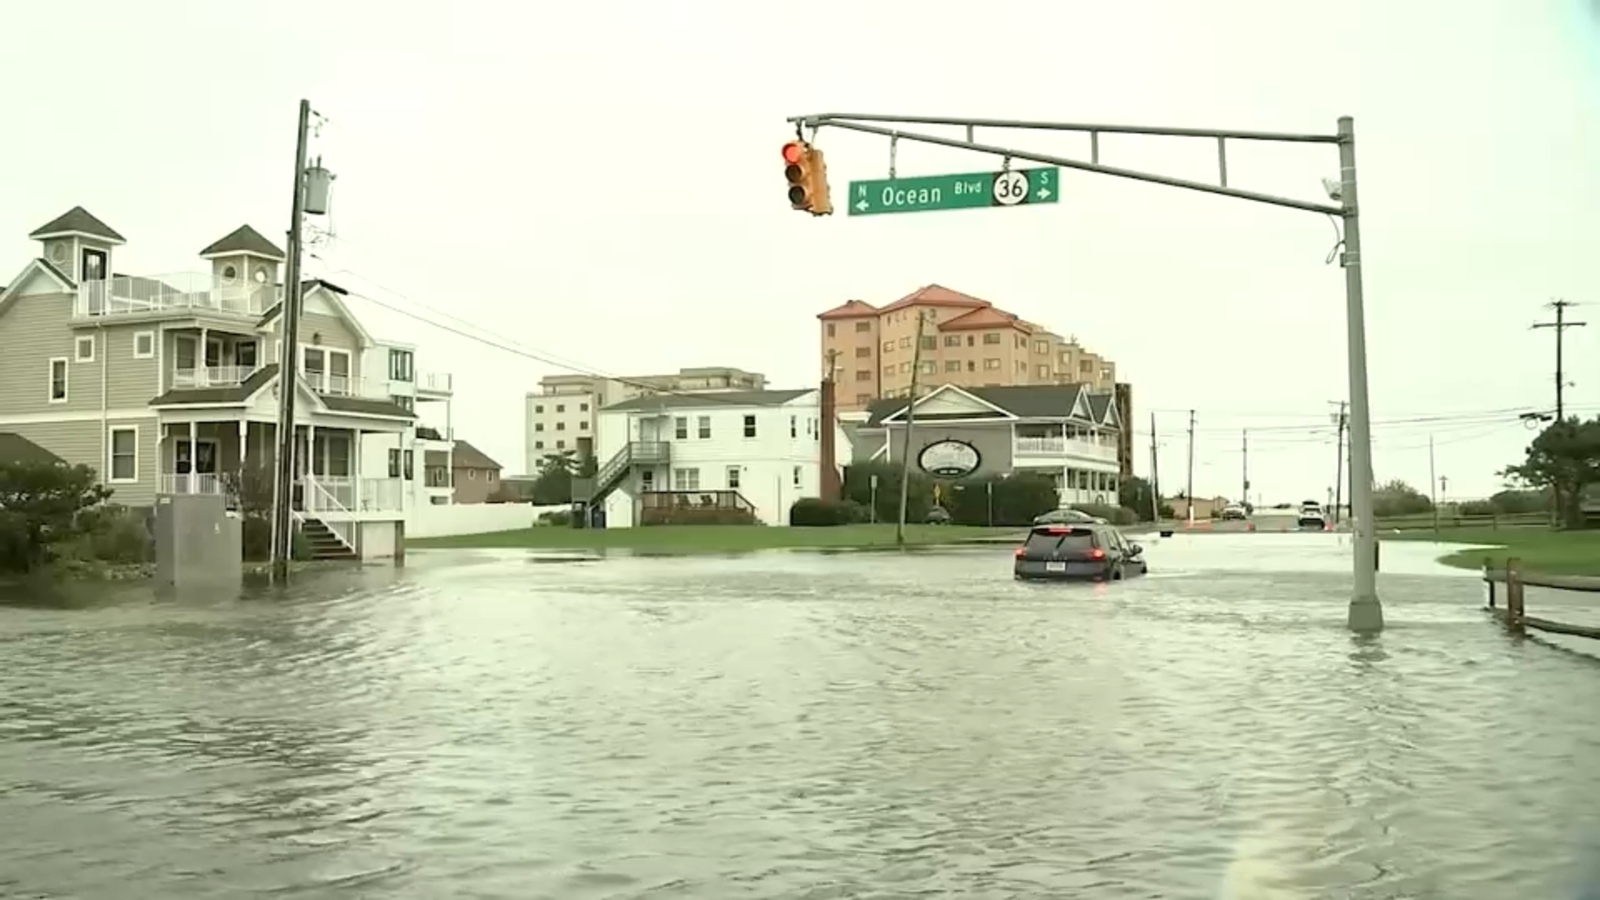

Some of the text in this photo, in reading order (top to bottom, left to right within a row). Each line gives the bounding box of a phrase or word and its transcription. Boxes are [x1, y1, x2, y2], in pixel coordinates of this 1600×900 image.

[858, 171, 1049, 206] N Ocean Blvd 36 S
